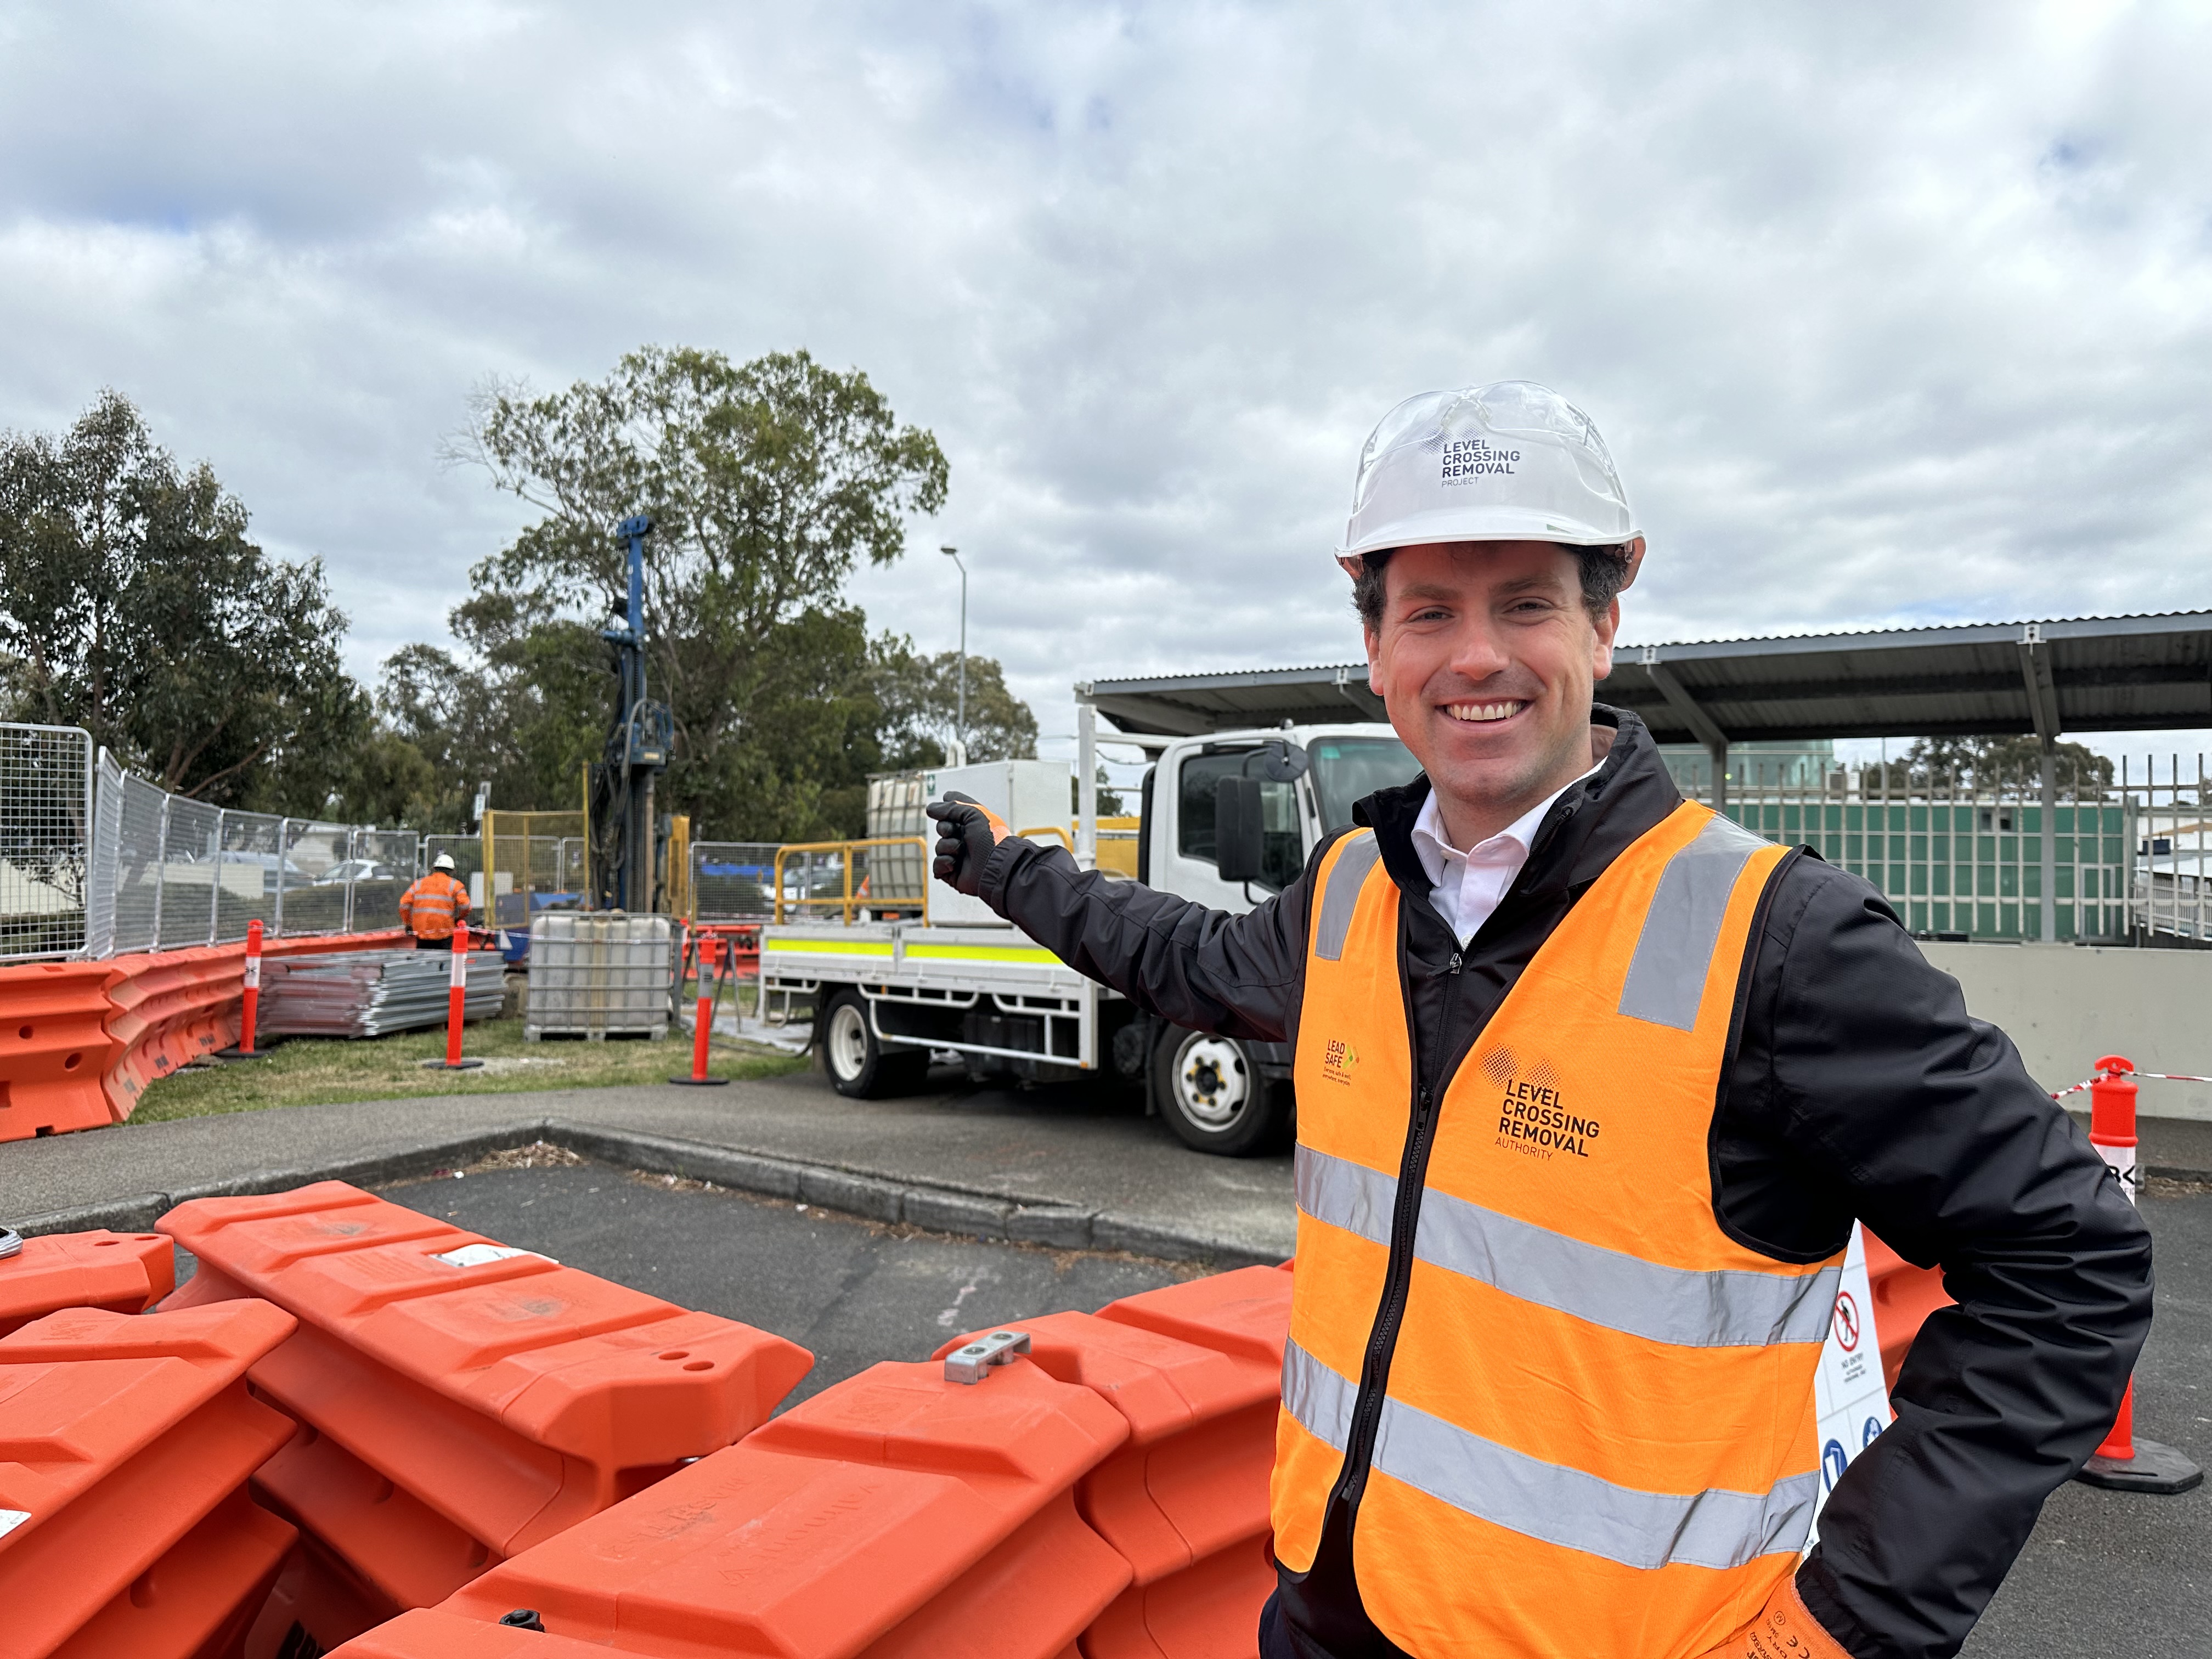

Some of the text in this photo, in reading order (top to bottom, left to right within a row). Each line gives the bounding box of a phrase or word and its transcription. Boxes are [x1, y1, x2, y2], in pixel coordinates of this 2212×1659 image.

[1444, 439, 1489, 454] LEVEL
[1443, 450, 1520, 466] CROSSING
[1442, 463, 1515, 478] REMOVAL
[1442, 477, 1479, 488] PROJECT
[1327, 1039, 1345, 1054] LEAD
[1325, 1052, 1343, 1068] SAFE
[1505, 1078, 1564, 1110] LEVEL
[1502, 1098, 1600, 1138] CROSSING
[1499, 1116, 1589, 1158] REMOVAL
[1494, 1136, 1554, 1161] AUTHORITY
